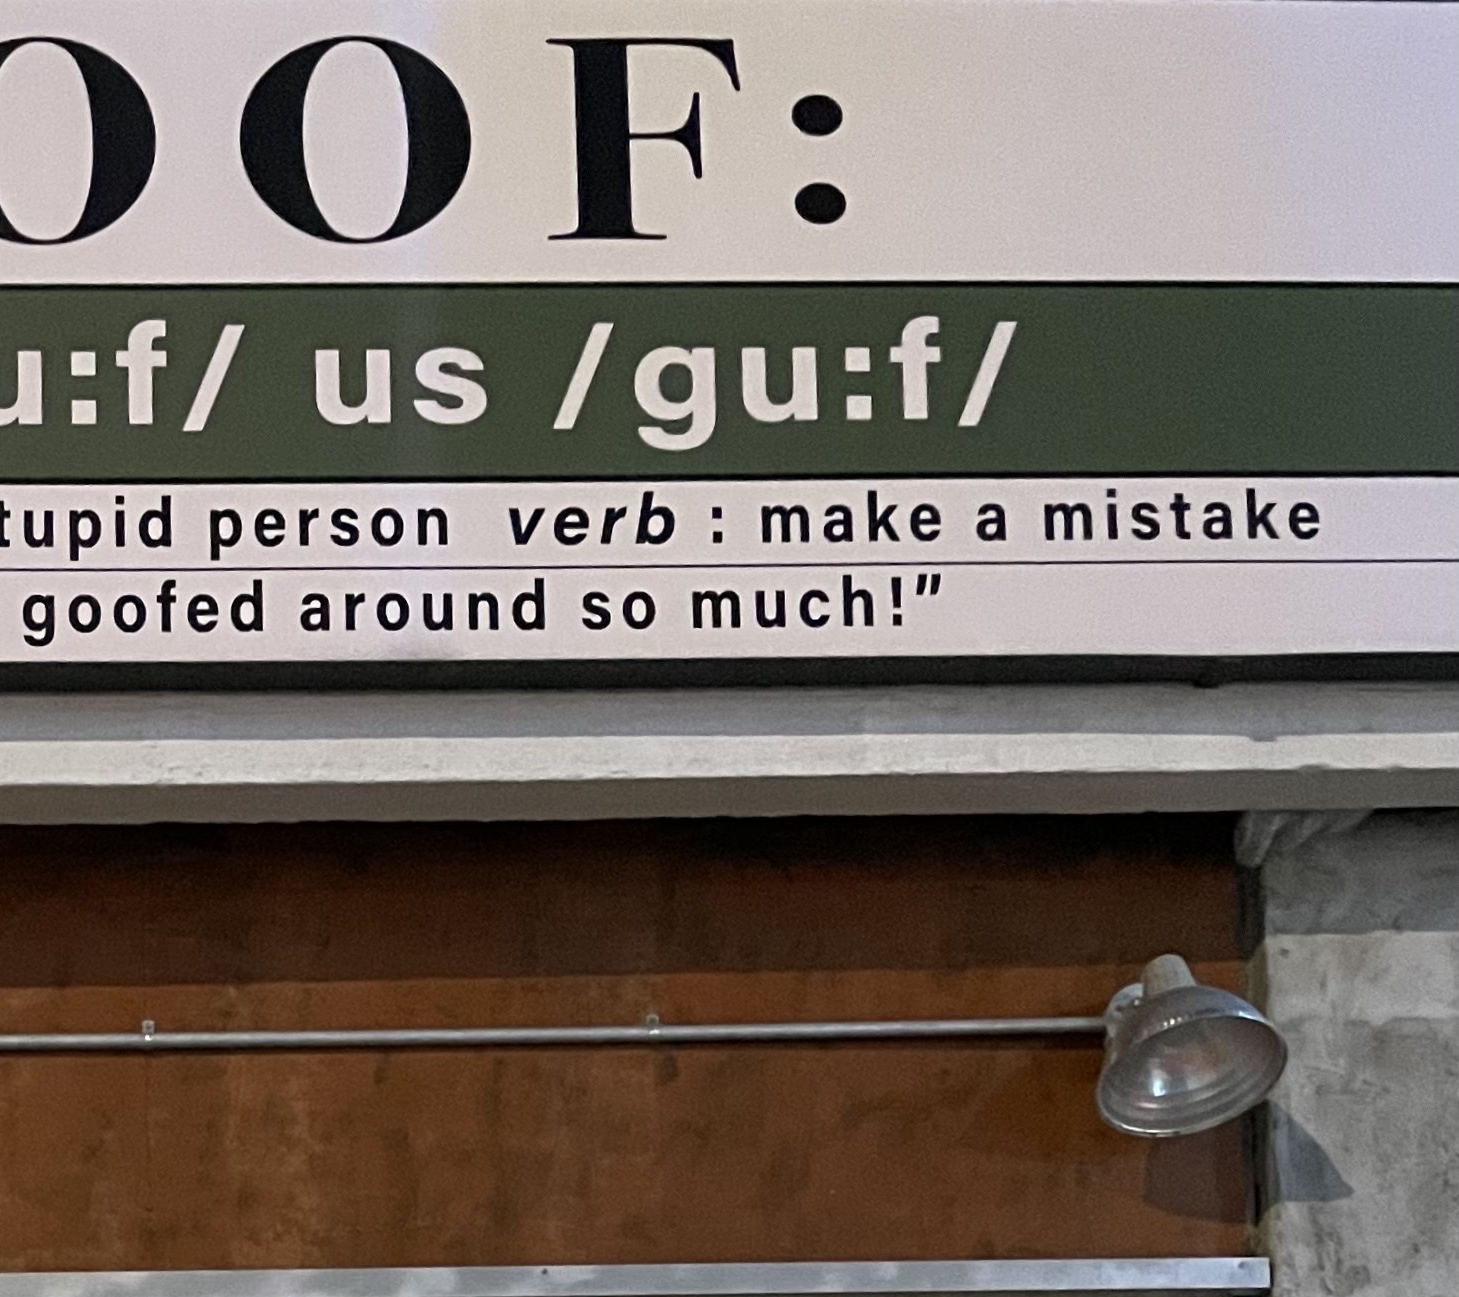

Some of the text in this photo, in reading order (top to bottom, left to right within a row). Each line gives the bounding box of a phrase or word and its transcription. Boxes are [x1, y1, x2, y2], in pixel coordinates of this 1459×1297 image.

[315, 347, 488, 425] us
[553, 315, 1018, 451] /gu:f/
[208, 506, 449, 562] person
[507, 489, 676, 547] verb
[759, 488, 943, 545] make
[975, 502, 1008, 543] a
[1043, 487, 1322, 542] mistake
[21, 578, 265, 648] goofed
[299, 576, 547, 633] around
[580, 590, 657, 632] so
